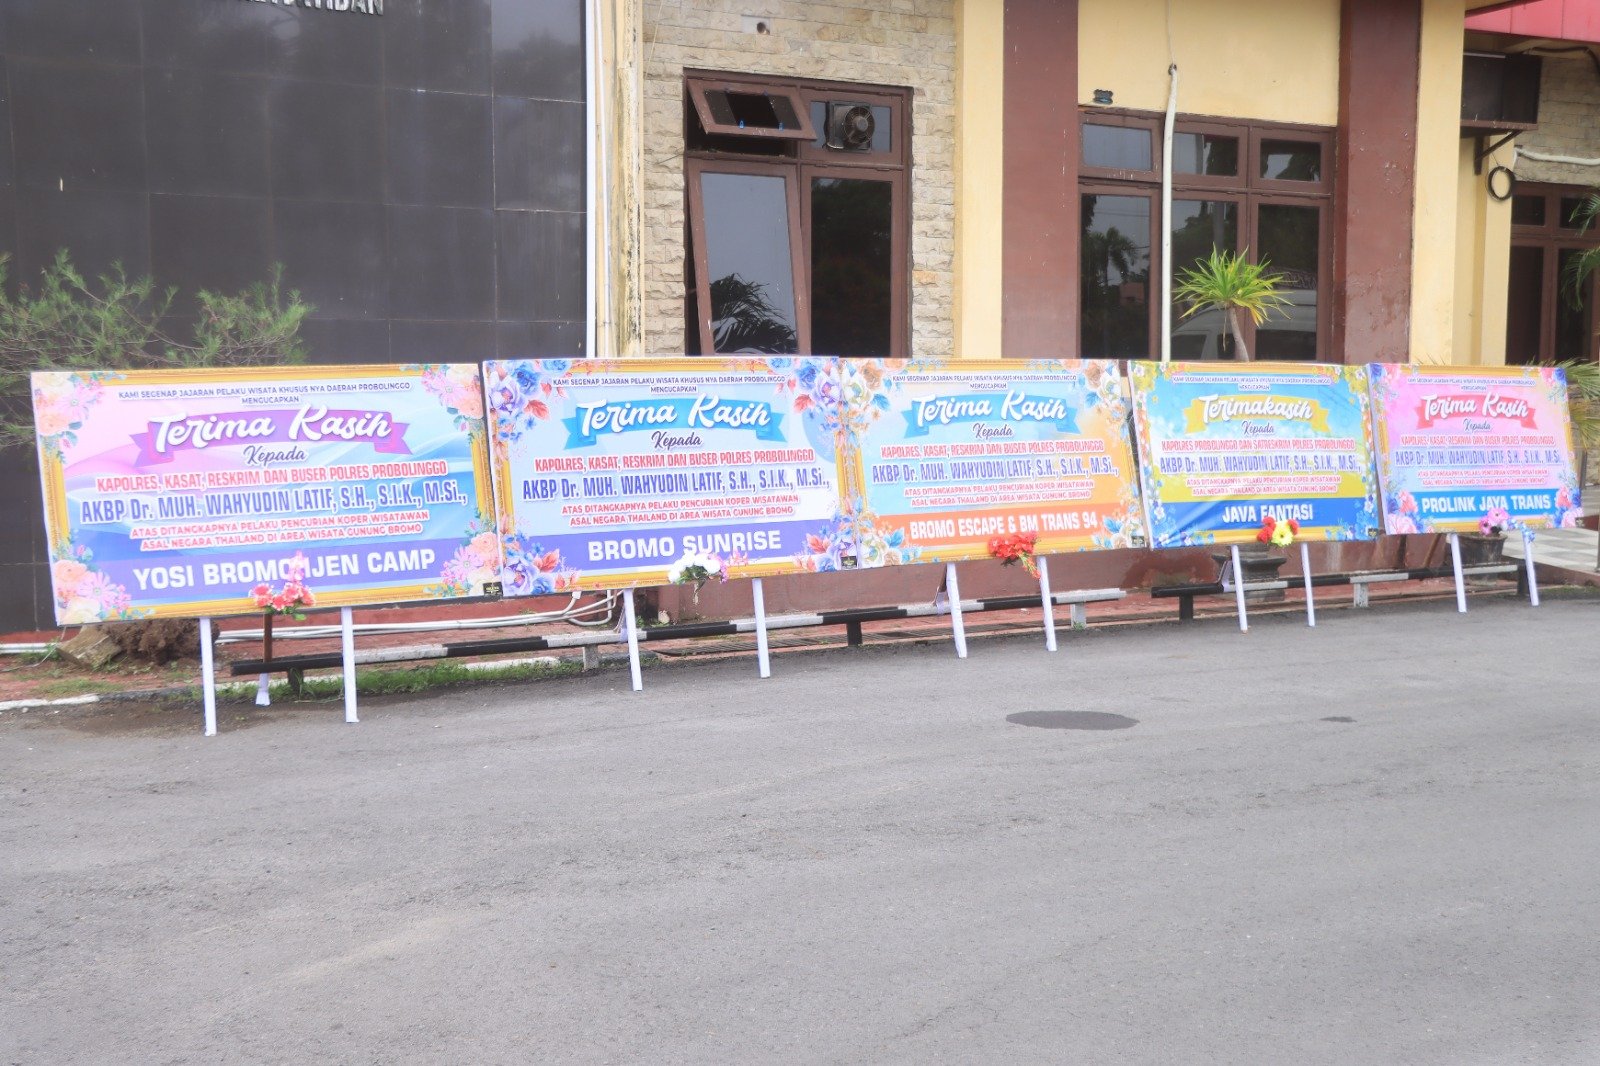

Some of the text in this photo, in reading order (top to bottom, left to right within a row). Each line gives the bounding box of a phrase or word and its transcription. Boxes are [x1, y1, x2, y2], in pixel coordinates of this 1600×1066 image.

[577, 393, 769, 435] Terima Kasih
[913, 390, 1065, 425] Terima Kasih
[1199, 395, 1311, 422] Terimakasih
[1423, 393, 1527, 419] Terima Kasih
[149, 403, 391, 451] Terima Kasih
[973, 422, 1013, 438] Kepada
[1242, 421, 1274, 435] Kepada
[1463, 419, 1491, 431] Kepada
[652, 430, 702, 449] Kepada
[244, 444, 306, 465] Kepada
[623, 455, 665, 468] RESKRIM
[668, 454, 687, 466] DAN
[689, 452, 717, 465] BUSER
[720, 451, 752, 464] POLRES
[754, 448, 813, 462] PROBOLINGGO
[207, 470, 260, 486] RESKRIM
[264, 469, 287, 483] DAN
[291, 467, 325, 482] BUSER
[329, 465, 369, 480] POLRES
[372, 461, 446, 477] PROBOLINGGO
[522, 480, 557, 499] AKBP
[621, 473, 687, 493] WAHYUDIN
[81, 499, 125, 521] AKBP
[205, 491, 289, 514] WAHYUDIN
[561, 494, 798, 514] ATAS DITANGKAPNYA PELAKU PENCURIAN KOPER WISATAWAN
[1221, 504, 1312, 523] JAVA FANTASI
[1421, 494, 1550, 512] PROLINK JAYA TRANS
[910, 519, 953, 539] BROMO
[958, 516, 1004, 536] ESCAPE
[1019, 514, 1038, 531] BM
[1041, 512, 1079, 530] TRANS
[1082, 511, 1097, 527] 94
[588, 530, 781, 561] BROMO SUNRISE
[133, 565, 193, 590] YOSI
[203, 558, 295, 584] BROMO
[365, 549, 436, 573] CAMP
